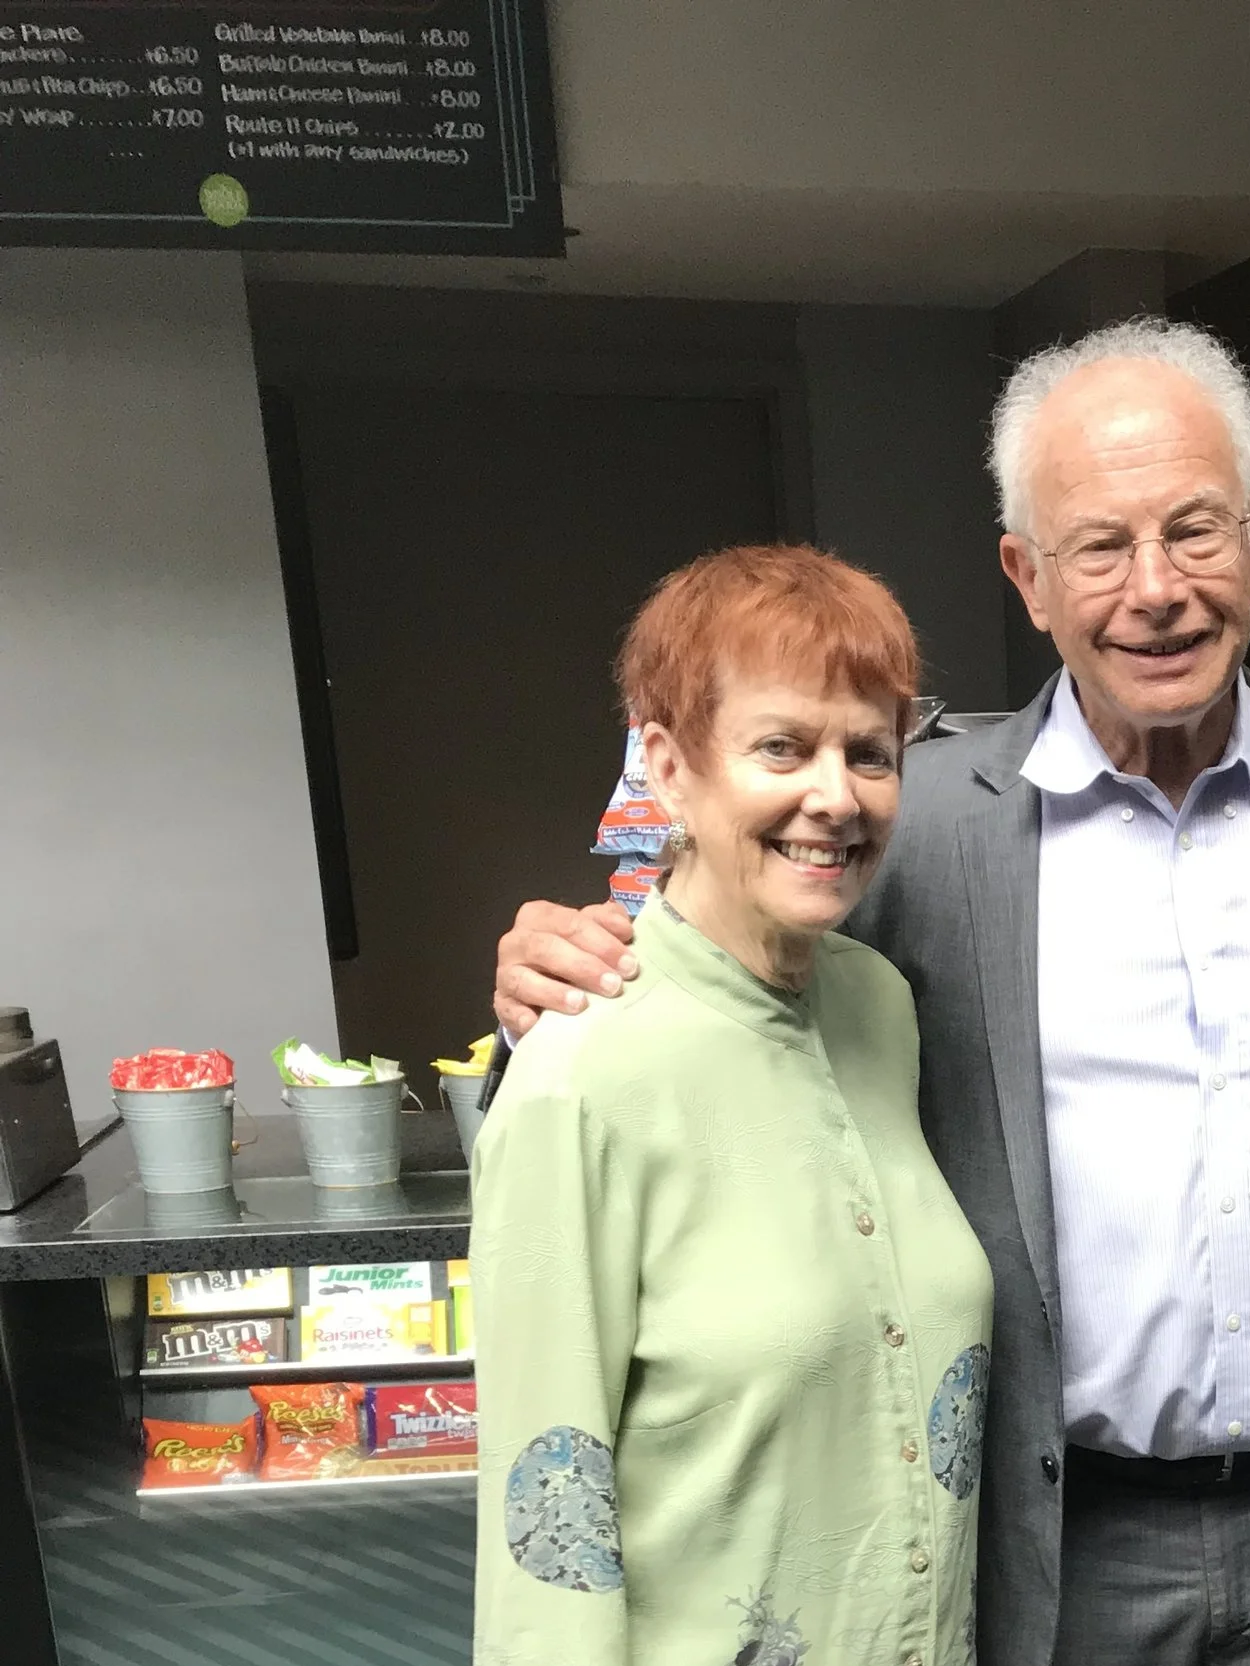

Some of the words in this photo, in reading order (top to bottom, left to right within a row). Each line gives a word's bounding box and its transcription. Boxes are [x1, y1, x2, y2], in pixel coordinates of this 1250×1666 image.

[215, 22, 275, 42] Grilled
[226, 115, 283, 135] Route
[259, 142, 300, 158] with
[303, 143, 343, 161] any
[348, 145, 469, 164] sandwiches)
[318, 1266, 409, 1283] Junior
[370, 1279, 424, 1291] Mints
[312, 1327, 394, 1343] Raisinets
[270, 1400, 345, 1422] Reese's
[153, 1433, 245, 1458] Reese's
